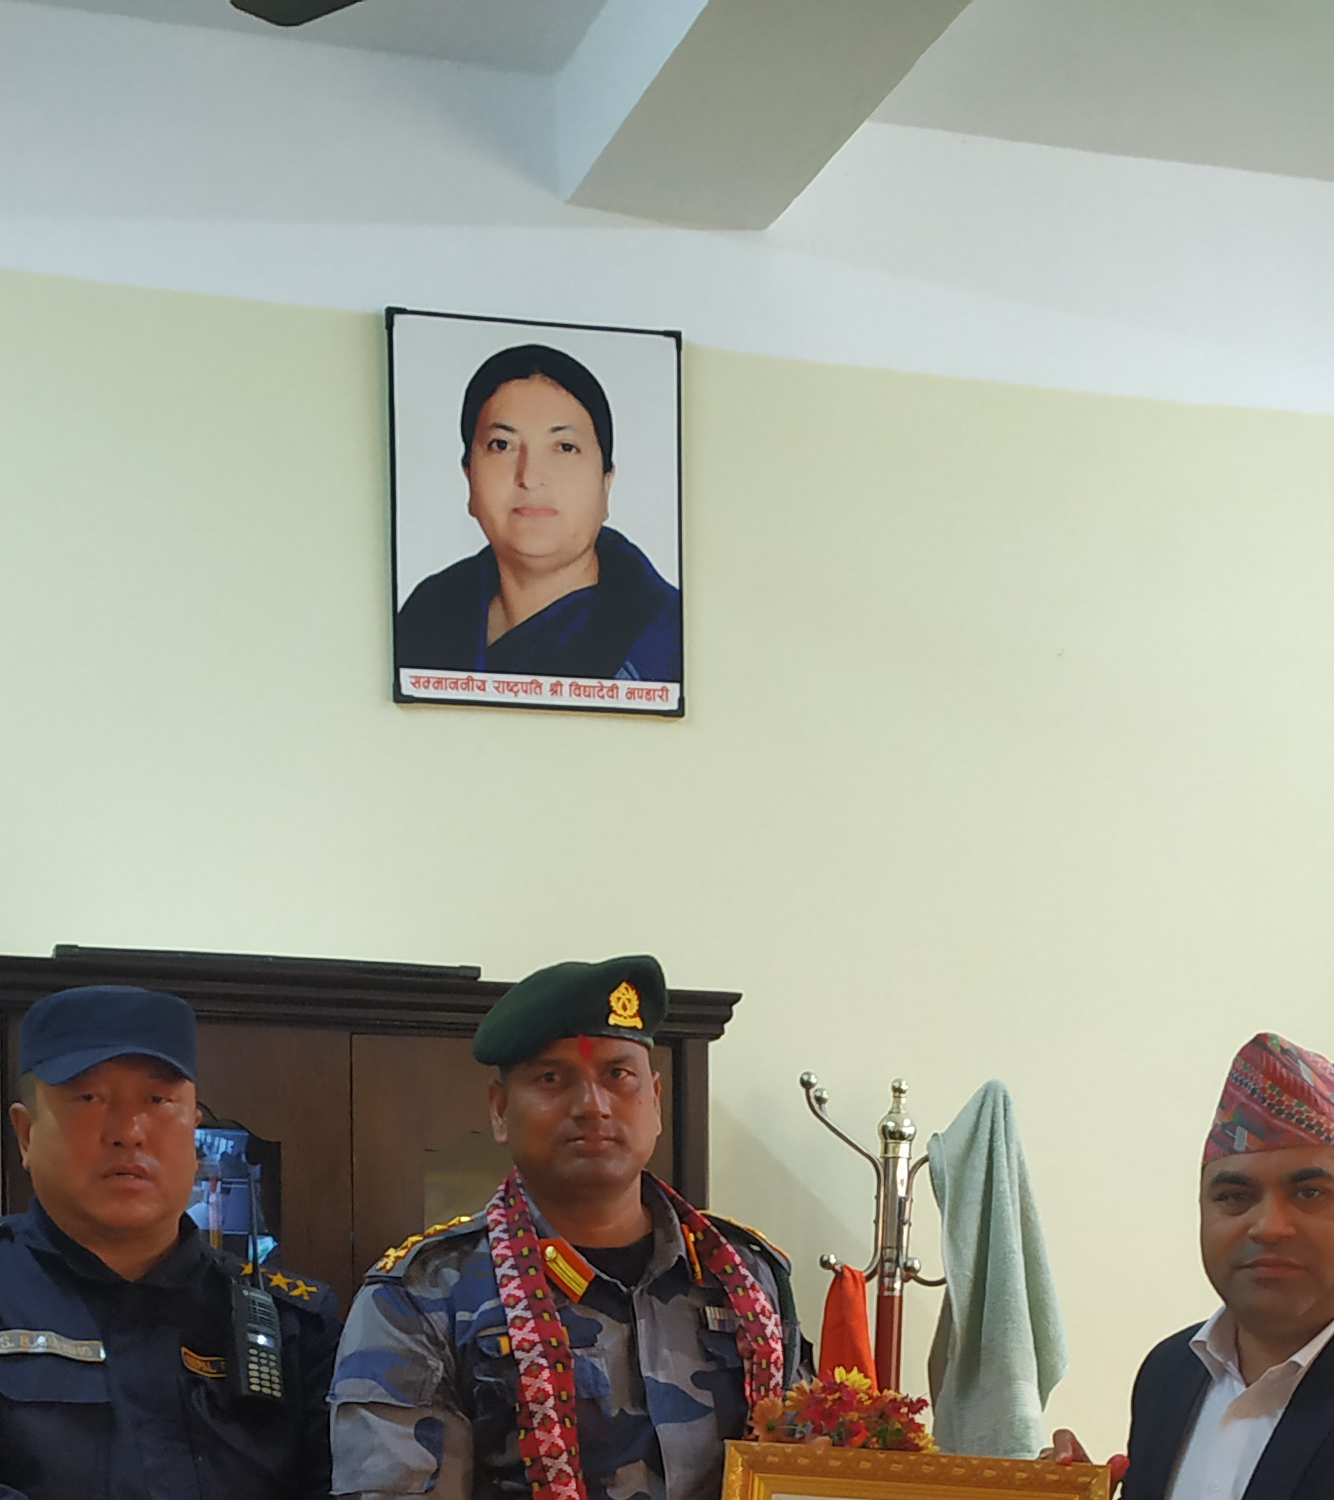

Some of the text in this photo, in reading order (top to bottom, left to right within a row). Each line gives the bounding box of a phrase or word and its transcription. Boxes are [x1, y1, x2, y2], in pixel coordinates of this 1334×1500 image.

[409, 675, 670, 701] सम्माननीय राष्ट्रपति श्री विद्यादेवी भण्डारी
